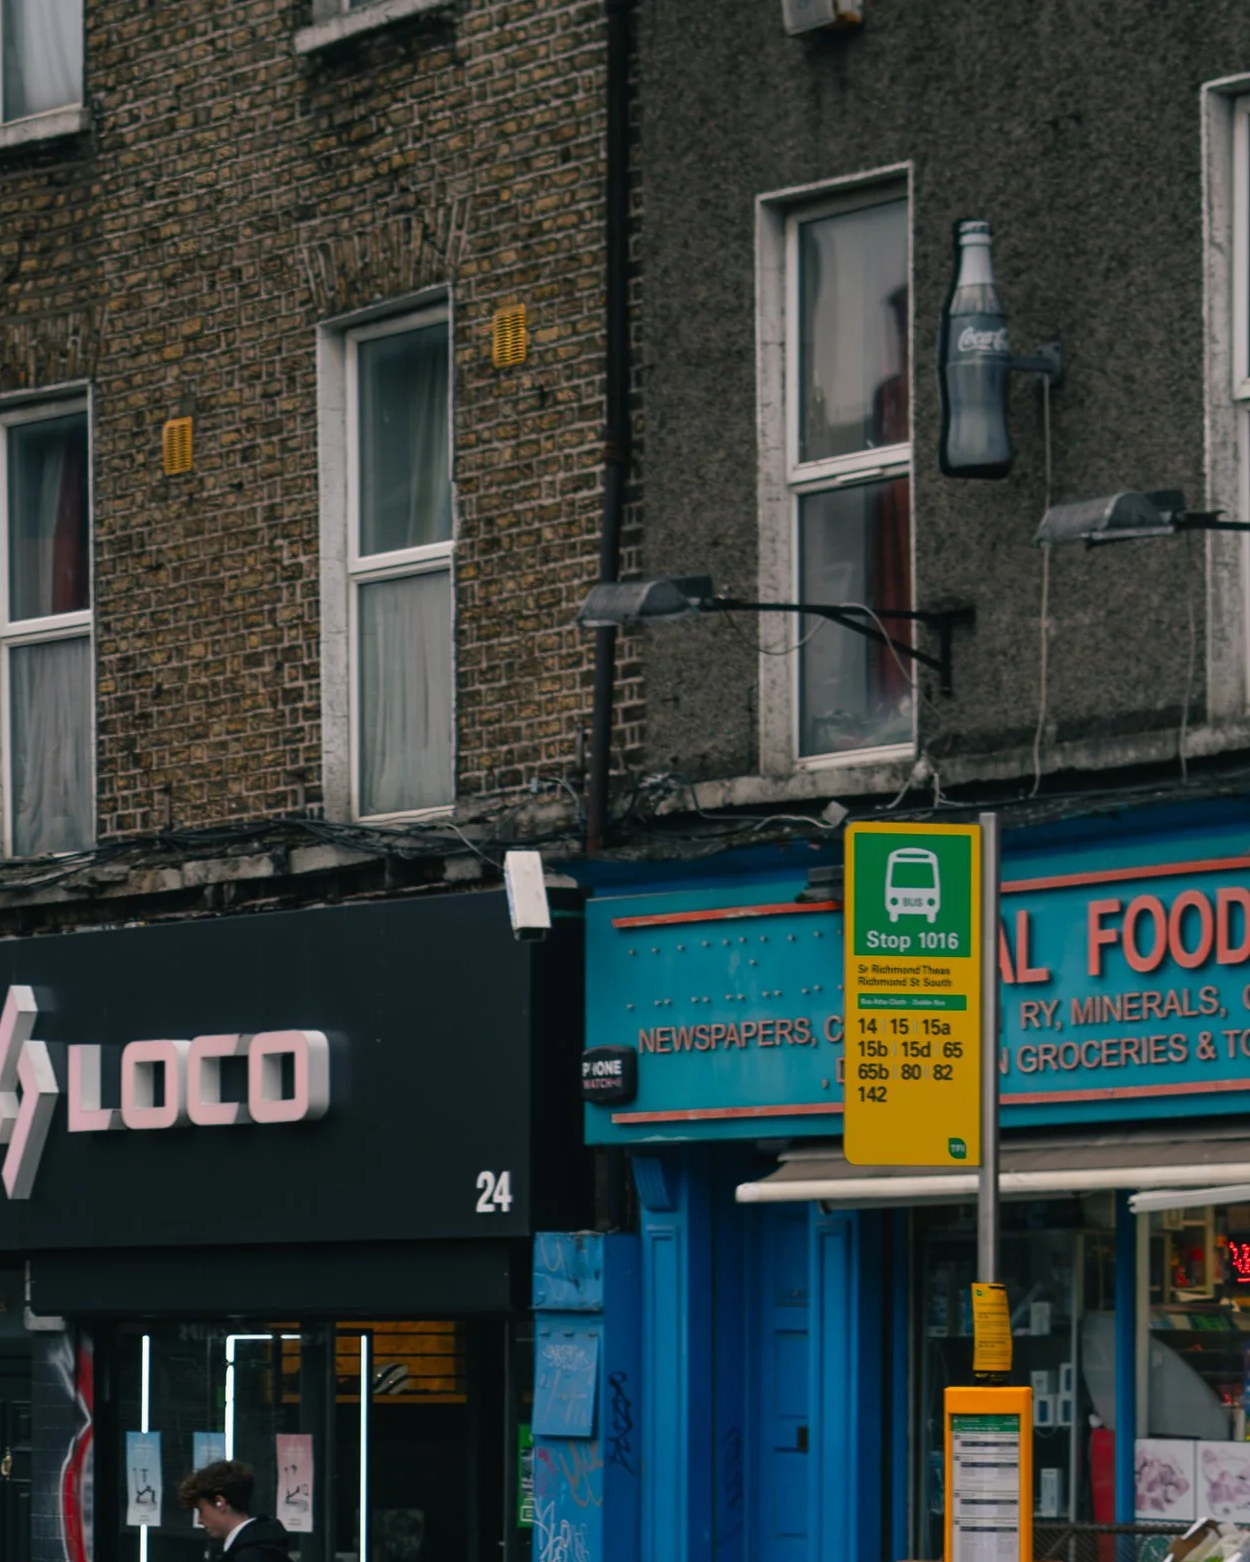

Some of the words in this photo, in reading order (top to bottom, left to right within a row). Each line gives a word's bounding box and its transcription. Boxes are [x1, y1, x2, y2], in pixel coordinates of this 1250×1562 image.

[901, 897, 924, 908] BUS
[866, 930, 912, 953] Stop
[918, 931, 959, 950] 1016
[871, 964, 921, 975] Richmond
[858, 976, 908, 987] Richmond
[910, 977, 920, 988] St
[923, 977, 953, 988] South
[1070, 984, 1227, 1027] MINERALS,
[638, 1016, 817, 1055] NEWSPAPERS,
[857, 1017, 878, 1035] 14
[890, 1018, 910, 1036] 15
[922, 1018, 951, 1036] 15a
[857, 1040, 888, 1058] 15b
[901, 1040, 932, 1058] 15d
[942, 1041, 964, 1059] 65
[1016, 1033, 1189, 1075] GROCERIES
[1195, 1030, 1217, 1060] &
[67, 1028, 331, 1133] LOCO
[857, 1063, 890, 1081] 65b
[900, 1063, 922, 1081] 80
[932, 1063, 954, 1082] 82
[857, 1086, 888, 1103] 142
[475, 1170, 513, 1214] 24
